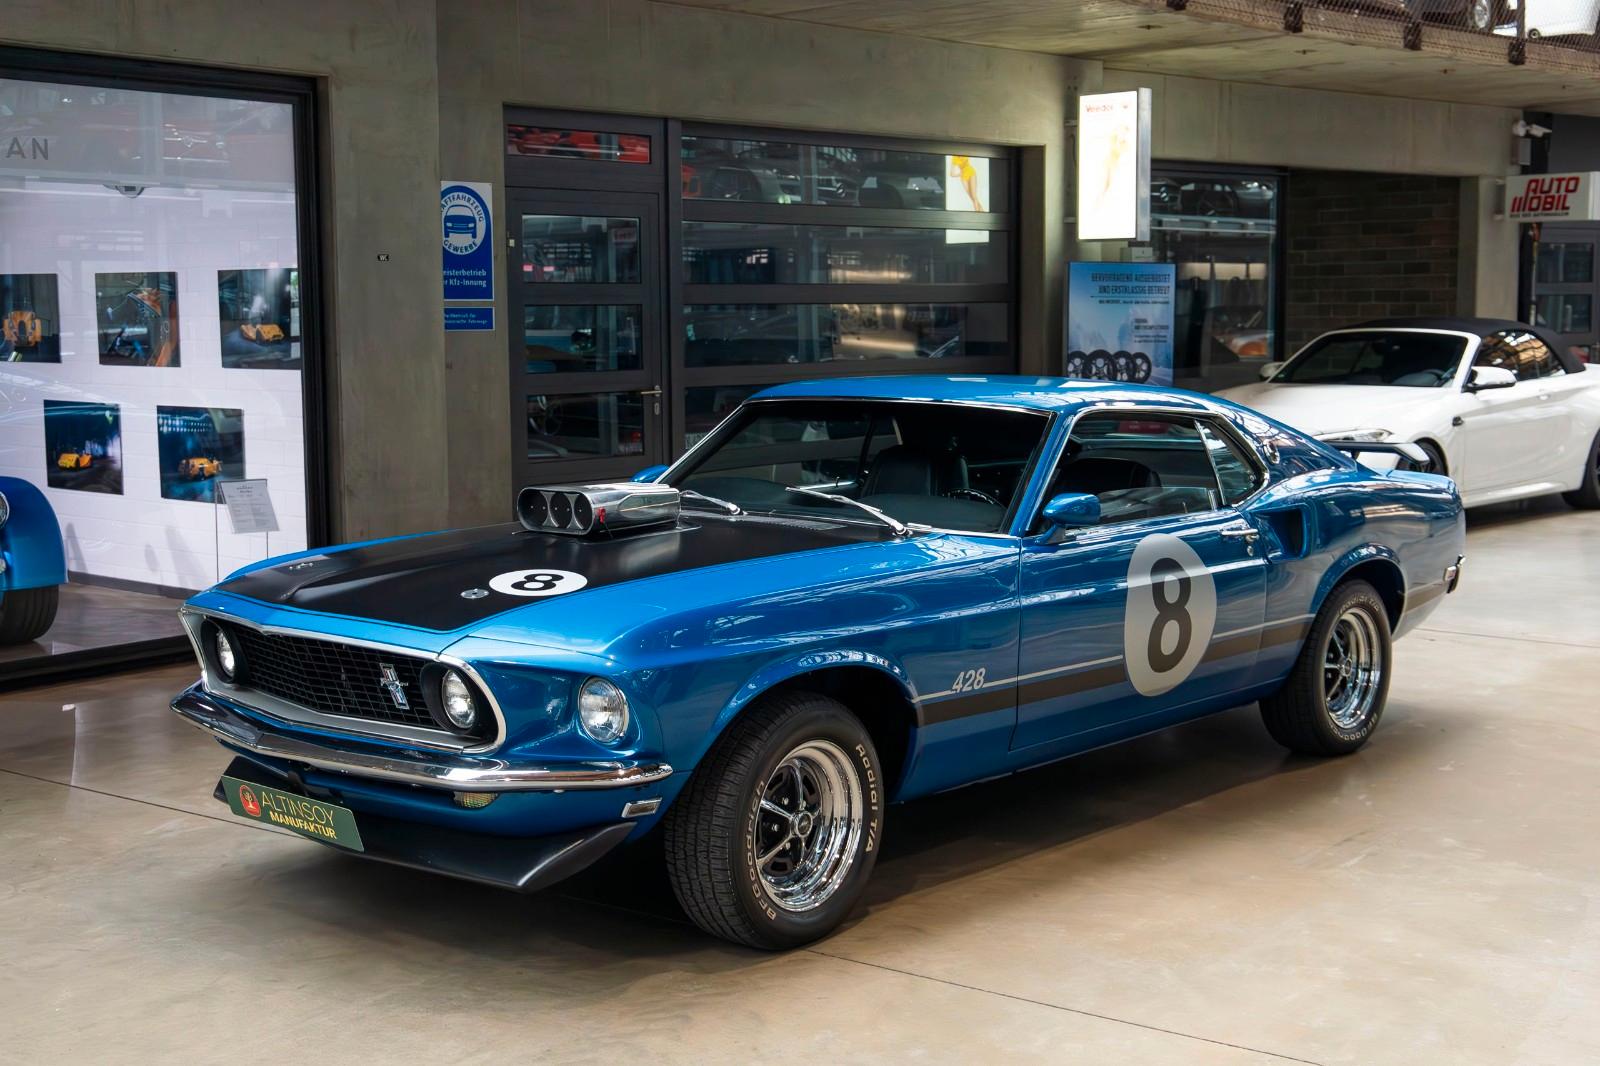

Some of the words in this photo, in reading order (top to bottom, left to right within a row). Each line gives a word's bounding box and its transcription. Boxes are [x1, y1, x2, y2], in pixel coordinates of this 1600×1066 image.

[5, 136, 49, 160] AN
[1525, 176, 1581, 195] AUTO
[441, 193, 485, 222] AFTFAHRZEUG
[1510, 193, 1571, 213] MOBIL
[443, 239, 478, 253] GEWERBE
[449, 278, 487, 288] Kfz-Innung
[510, 573, 565, 591] 8
[1147, 557, 1193, 674] 8
[951, 667, 987, 695] 428
[855, 743, 879, 812] Radial
[261, 791, 335, 827] ALTINSOY
[269, 810, 338, 840] MANUFAKTUR
[865, 818, 879, 853] T/A
[746, 780, 778, 921] BFGoodrich
